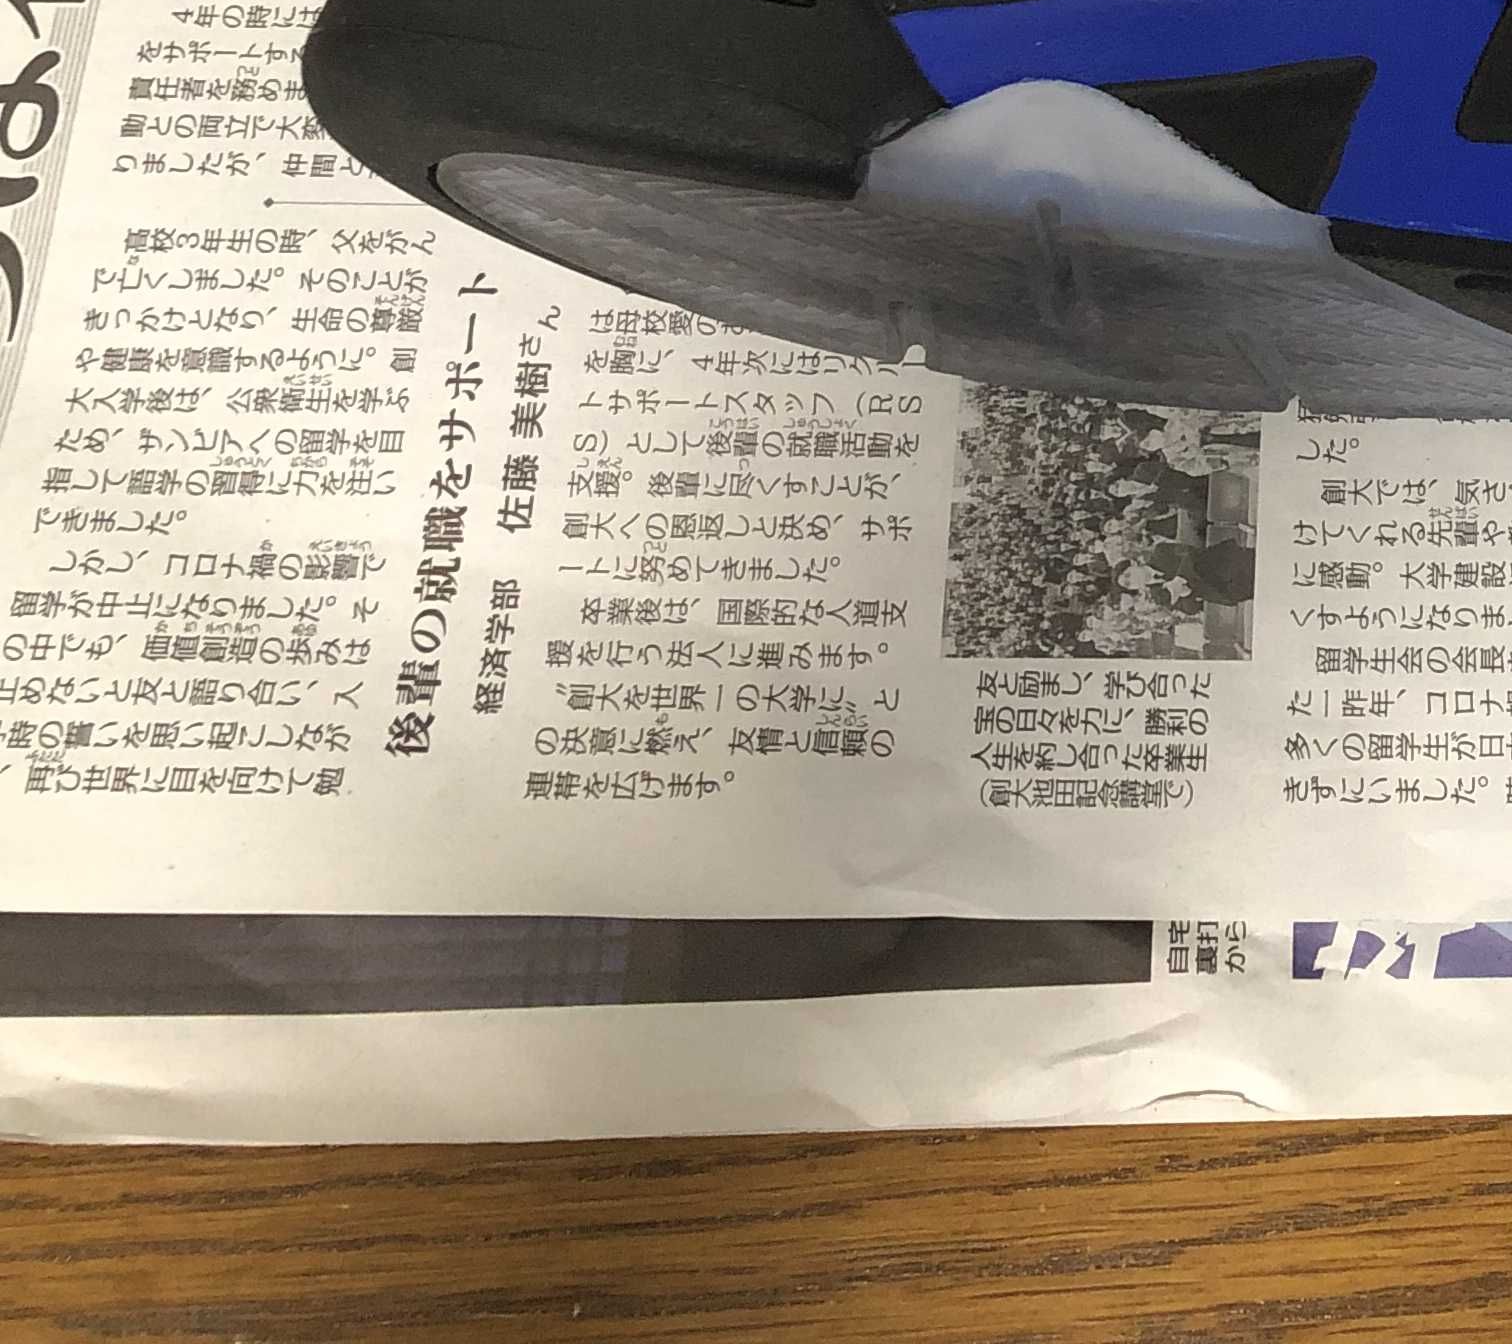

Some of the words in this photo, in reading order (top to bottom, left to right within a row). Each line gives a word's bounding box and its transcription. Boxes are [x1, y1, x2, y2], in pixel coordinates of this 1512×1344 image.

[124, 227, 437, 256] 高校3年生の時、父をがん
[91, 266, 429, 294] で亡くしました。そのことが
[84, 306, 424, 333] きっかけとなり、生命の尊厳
[74, 345, 418, 375] や健康を意識するように。創
[510, 305, 562, 439] 美樹さん
[66, 386, 409, 414] 大入学後は、公衆衛生を学ぶ
[577, 387, 922, 416] トサポートスタッフ（RS
[55, 428, 405, 456] ため、ザンビアへの留学を目
[574, 429, 920, 458] S）として後輩の就職活動を
[1296, 436, 1361, 466] した。
[42, 467, 397, 497] 指して語学の習得に力を注い
[497, 454, 540, 533] 佐藤
[567, 469, 902, 500] 支援。後輩に尽くすことが、
[33, 506, 189, 536] できました。
[384, 271, 497, 757] 後輩の就職をサポート
[562, 512, 913, 542] 創大への恩返しと決め、サポ
[49, 549, 387, 582] しかし、コロナ禍の影響で
[559, 554, 842, 584] ートに努めてきました。
[10, 589, 380, 624] 留学が中止になりました。そ
[580, 596, 909, 627] 卒業後は、国際的な人道支
[1, 633, 372, 667] の中でも、価値創造の歩みは
[472, 578, 521, 714] 経済学部
[546, 640, 890, 670] 援を行う法人に進みます。
[975, 670, 1212, 700] 友と励まし、学び合った
[972, 705, 1209, 737] 宝の日々を力に、勝利の
[533, 726, 896, 758] の決意に燃え、友情と信頼の
[970, 742, 1209, 773] 人生を約し合った卒業生
[523, 770, 737, 801] 連帯を広げます。
[979, 778, 1194, 808] （創大池田記念講堂で）
